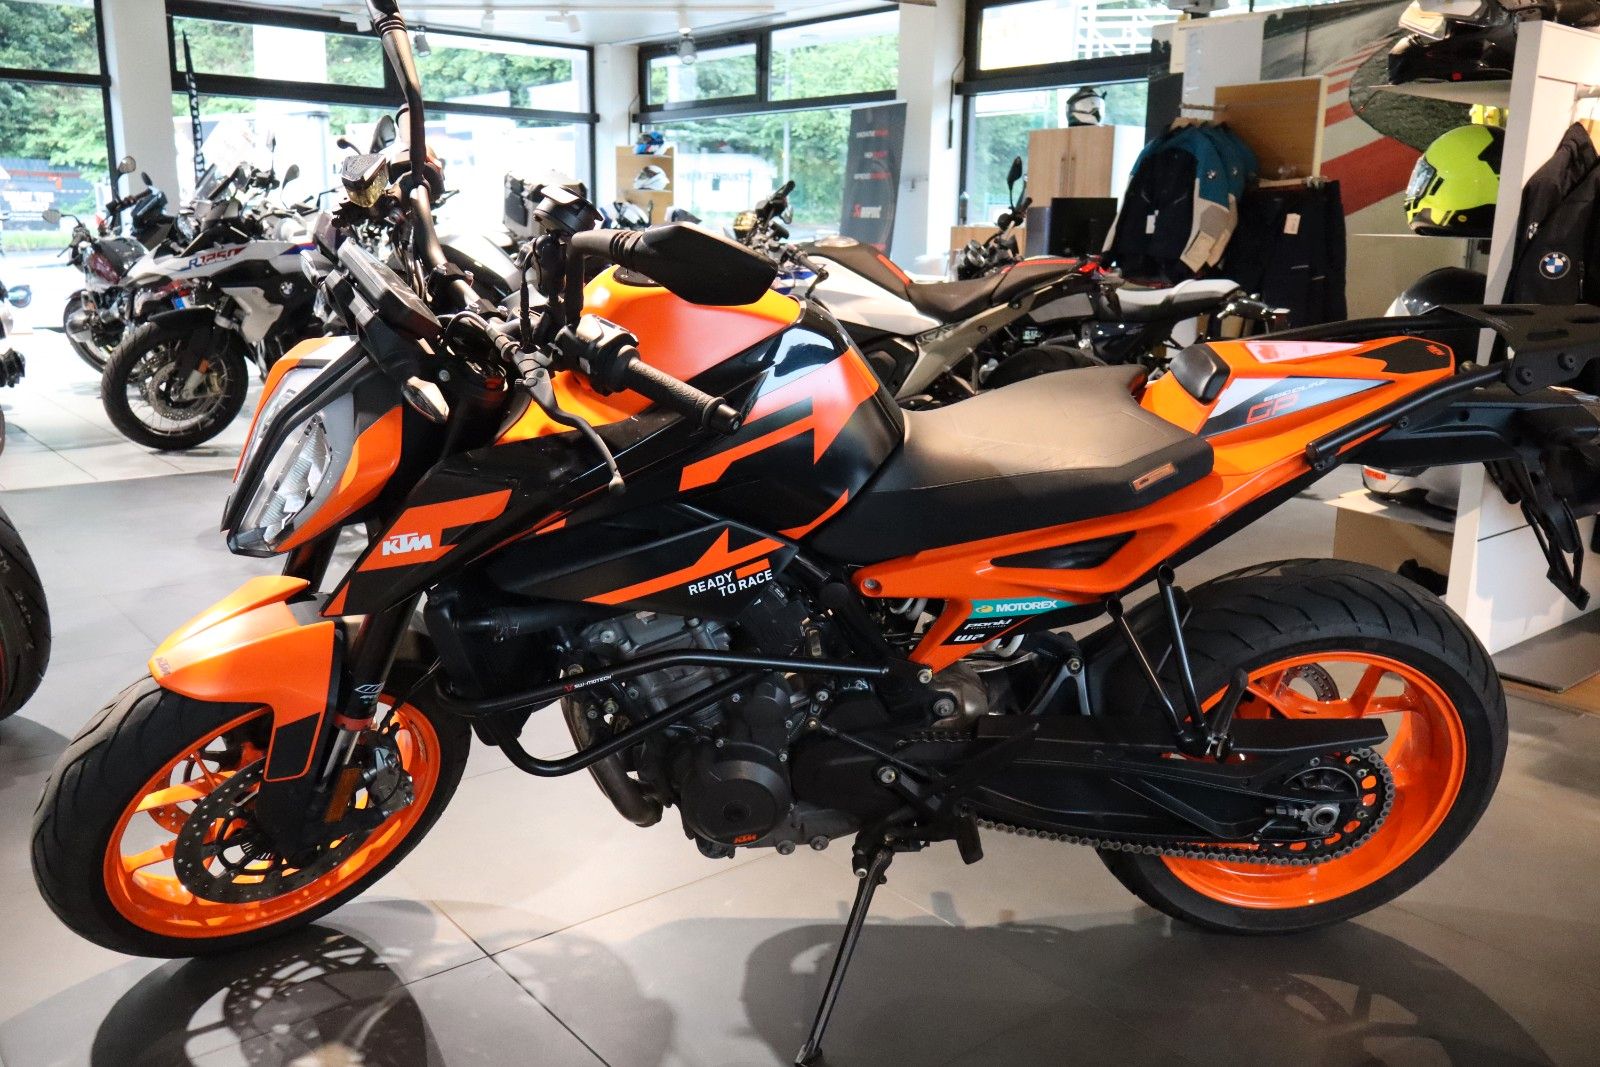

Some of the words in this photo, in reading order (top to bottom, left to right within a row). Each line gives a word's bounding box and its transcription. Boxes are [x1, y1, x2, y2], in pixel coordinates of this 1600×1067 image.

[382, 532, 433, 556] KTM
[688, 571, 733, 596] READY
[718, 583, 737, 597] TO
[738, 569, 773, 591] RACE
[996, 600, 1058, 613] MOTOREX
